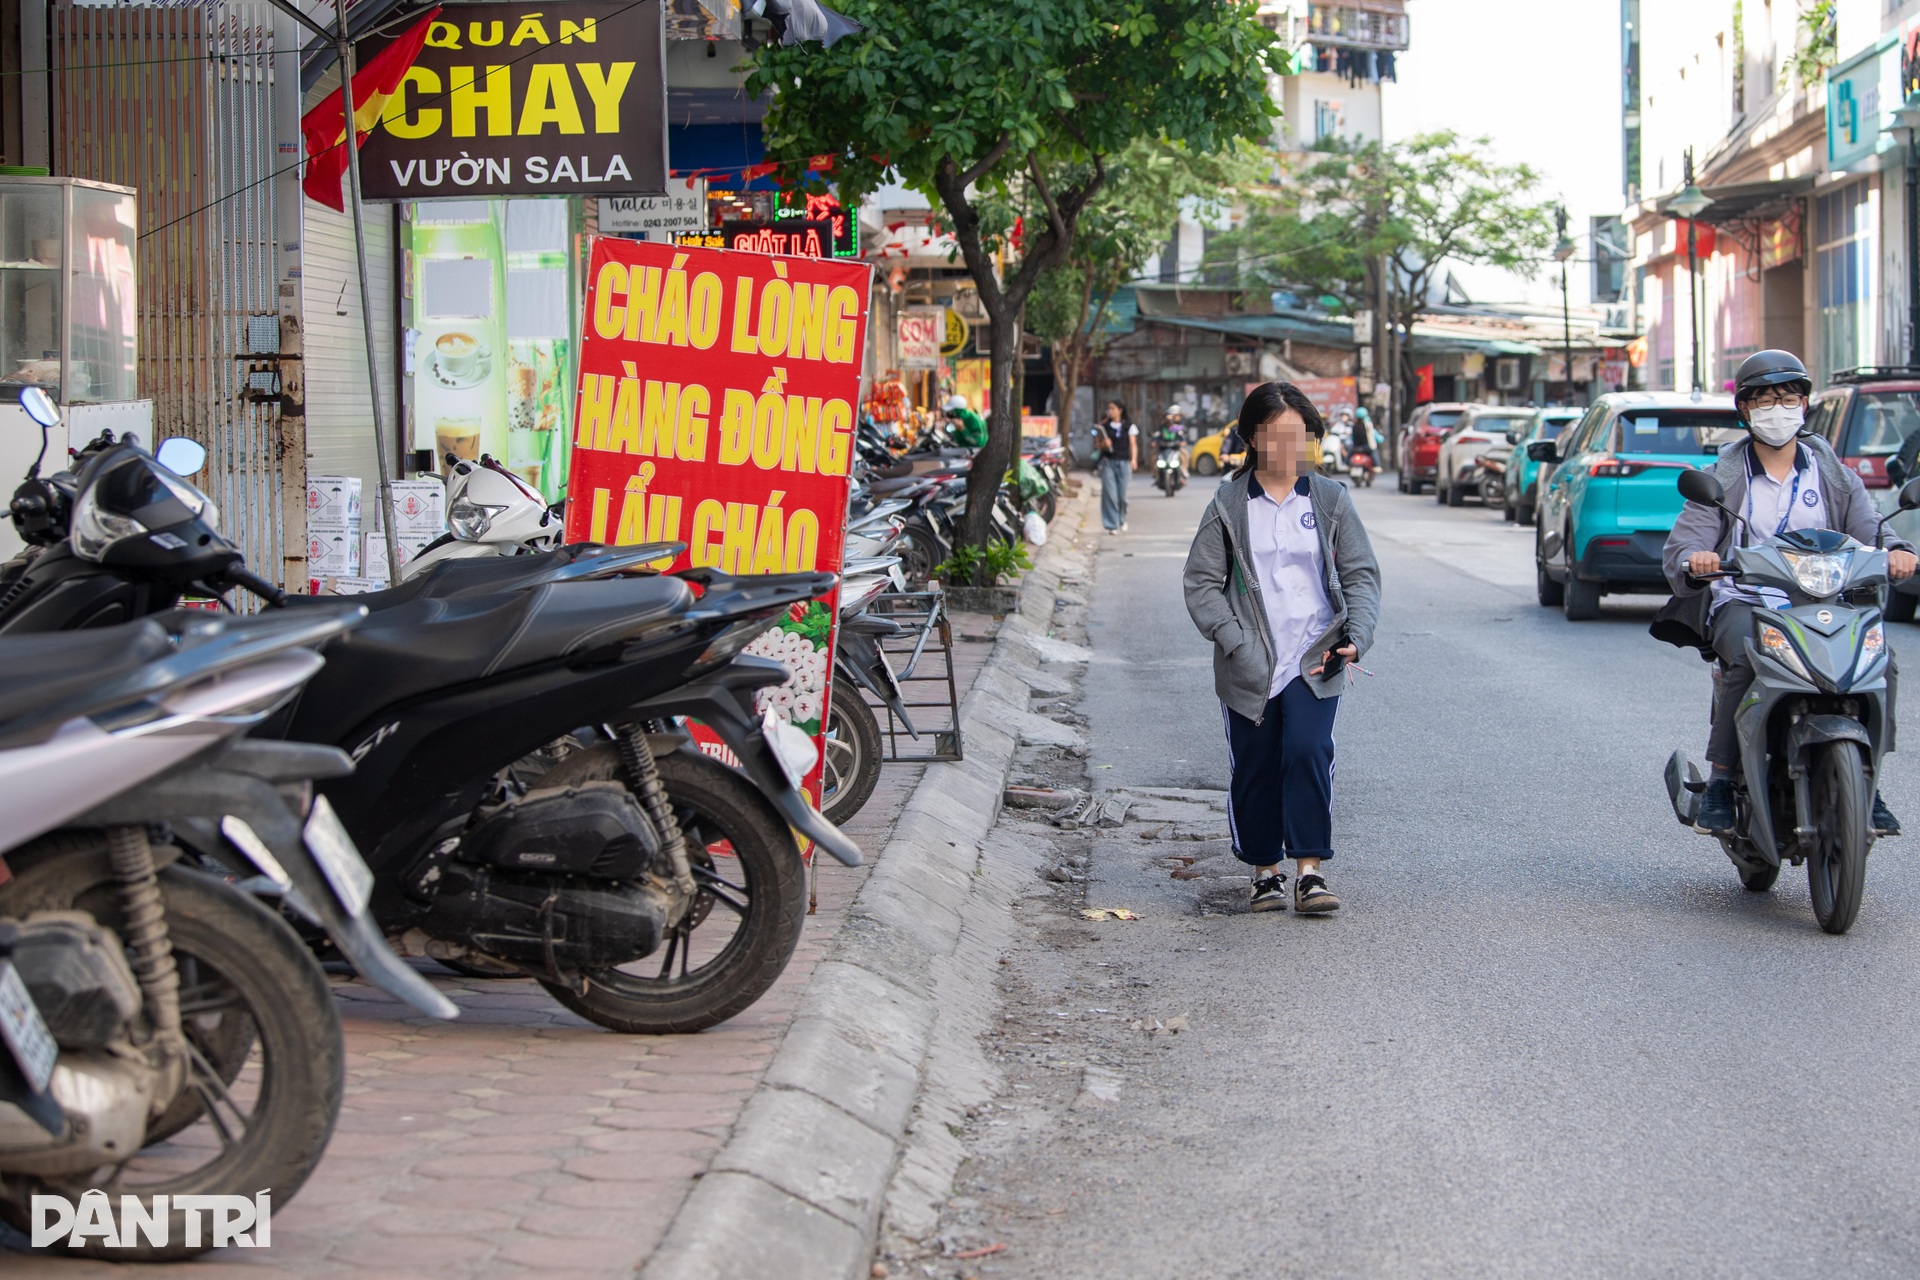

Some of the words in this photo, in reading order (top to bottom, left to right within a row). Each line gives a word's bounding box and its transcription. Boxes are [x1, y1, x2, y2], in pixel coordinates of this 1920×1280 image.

[424, 13, 597, 49] QUÁN
[383, 61, 636, 140] CHAY
[390, 151, 511, 187] VƯỜN
[525, 155, 632, 183] SALA
[643, 219, 662, 228] 0243
[663, 217, 682, 227] 2007
[684, 217, 698, 226] 504
[662, 197, 698, 211] 미용실
[594, 253, 722, 350] CHÁO
[731, 261, 859, 363] LÒNG
[577, 361, 710, 462] HÀNG
[719, 367, 852, 476] ĐỒNG
[690, 490, 819, 575] CHÁO
